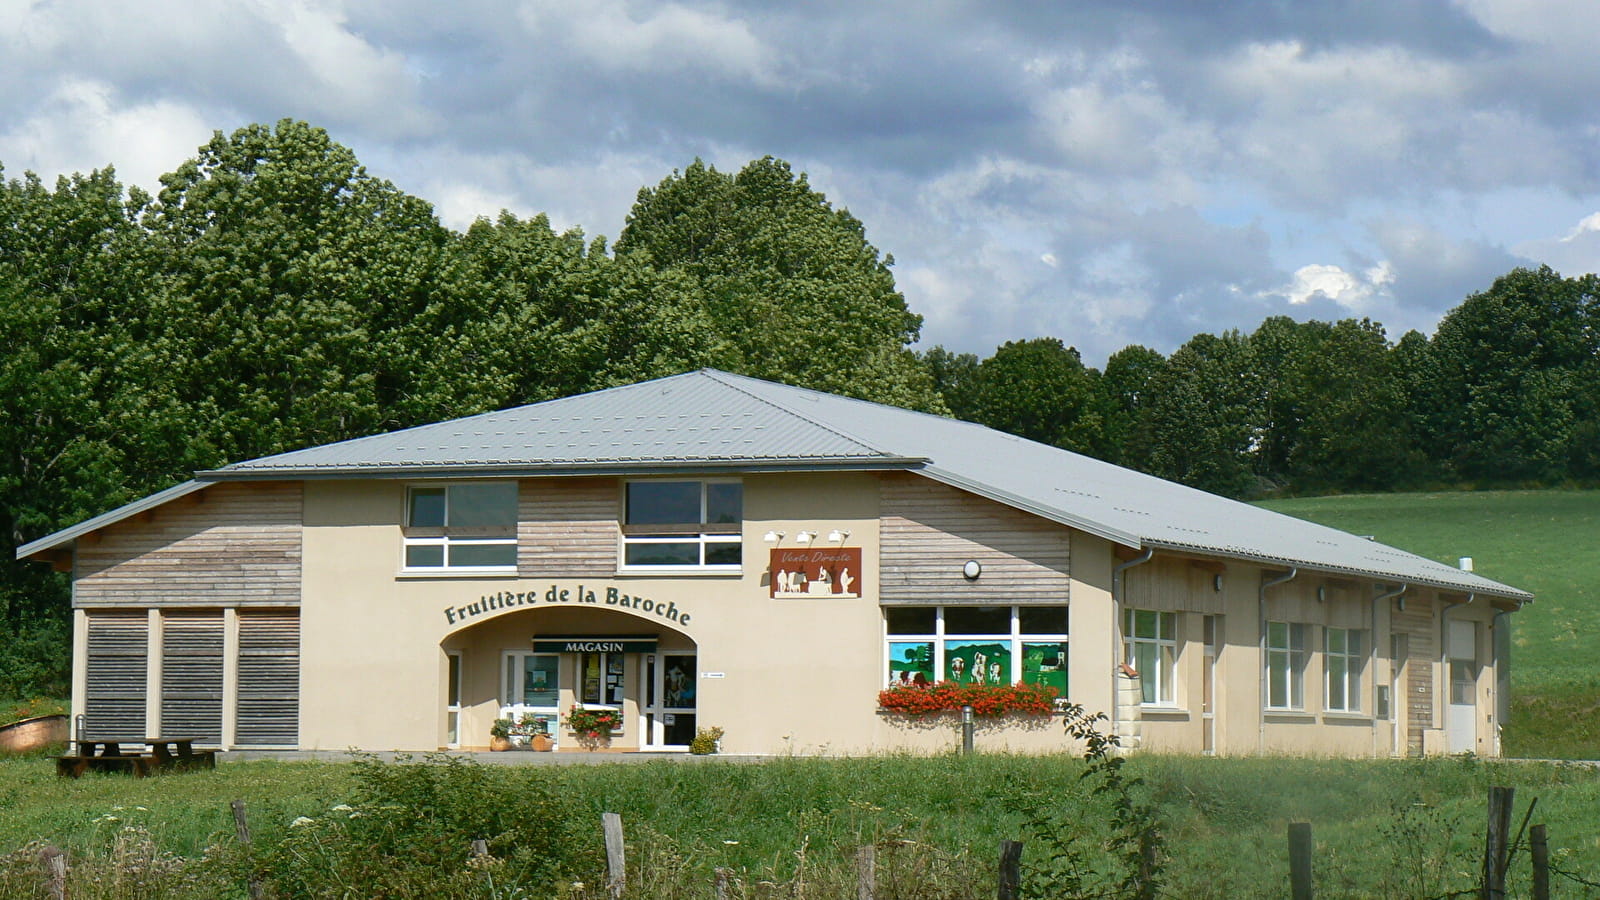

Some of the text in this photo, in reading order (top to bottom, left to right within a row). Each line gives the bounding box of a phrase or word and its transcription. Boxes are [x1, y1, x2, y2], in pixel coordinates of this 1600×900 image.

[782, 551, 851, 562] Vente Directe
[444, 585, 691, 626] Fruitière de la Baroche
[565, 642, 624, 652] MAGASIN
